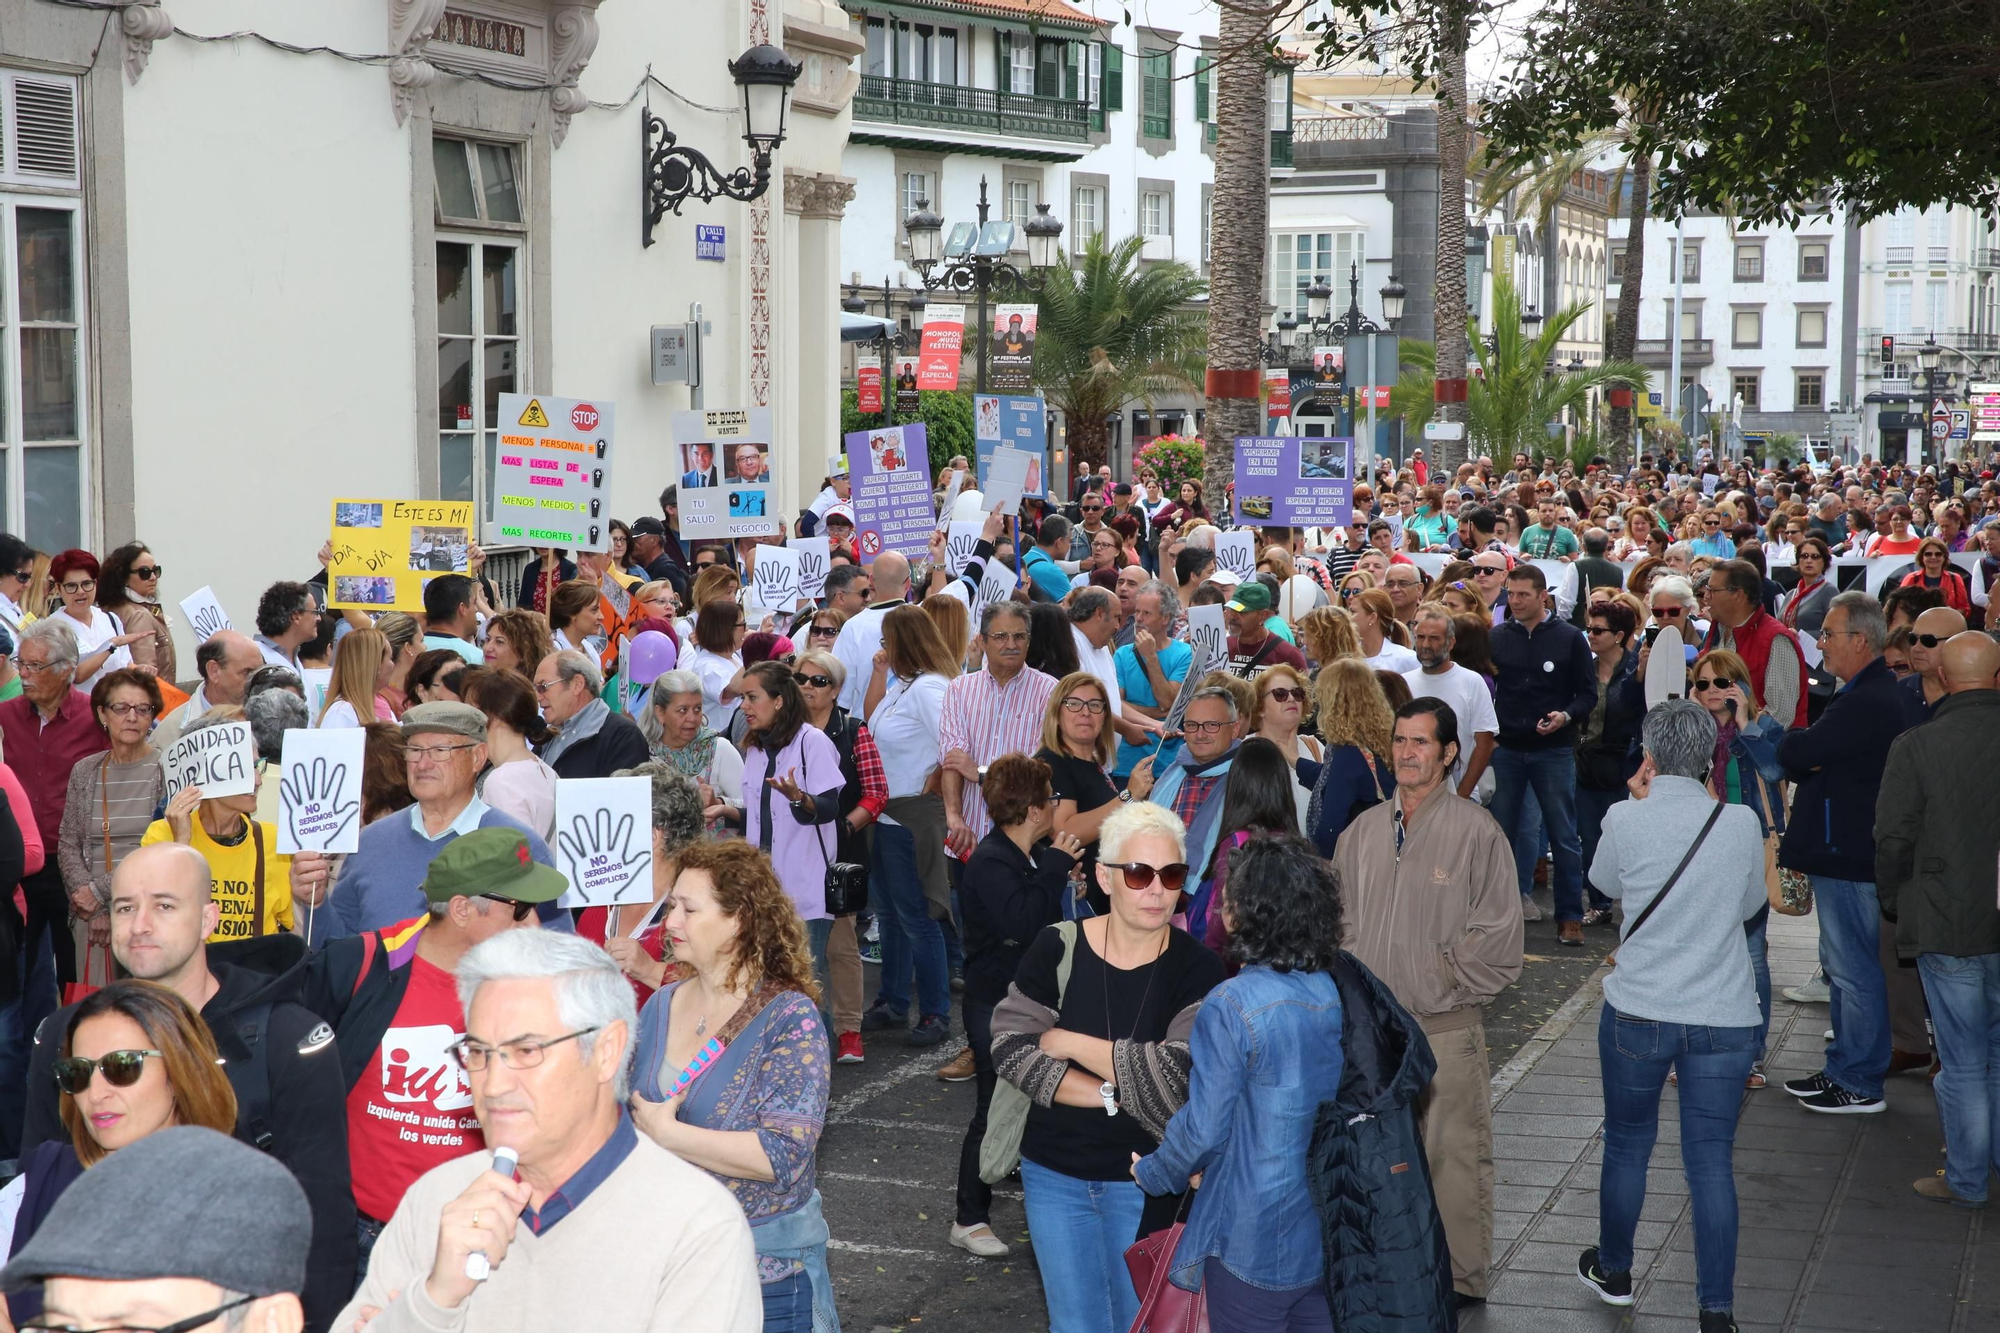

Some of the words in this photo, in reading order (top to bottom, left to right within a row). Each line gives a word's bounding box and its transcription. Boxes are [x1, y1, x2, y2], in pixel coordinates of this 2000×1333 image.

[705, 227, 724, 236] CALLE
[1501, 239, 1512, 274] Lectura
[924, 330, 961, 338] MONOPOL
[929, 342, 960, 350] FESTIVAL
[921, 370, 954, 379] ESPECIAL
[1363, 389, 1389, 398] Bter
[1650, 394, 1660, 403] 02
[1269, 403, 1290, 411] Binter
[572, 410, 598, 425] STOP
[706, 412, 717, 425] SE
[719, 410, 747, 424] BUSCA
[717, 427, 739, 435] WANTED
[1933, 425, 1947, 433] 40
[502, 436, 535, 446] MENOS
[540, 439, 585, 452] PERSONAL
[501, 456, 521, 466] MAS
[530, 458, 559, 470] LISTAS
[566, 463, 579, 473] DE
[530, 475, 564, 487] ESPERA
[863, 474, 887, 484] QUIERO
[891, 472, 921, 482] CUIDARTE
[861, 486, 885, 496] QUIERO
[888, 482, 927, 493] PROTEGERTE
[1313, 487, 1342, 495] QUIERO
[502, 496, 534, 507] MENOS
[540, 500, 575, 510] MEDIOS
[692, 500, 705, 508] TU
[856, 500, 876, 509] COMO
[878, 498, 888, 507] TU
[891, 496, 899, 505] TE
[901, 493, 928, 503] MERECES
[393, 502, 424, 520] ESTE
[428, 508, 445, 521] ES
[859, 513, 875, 522] PERO
[879, 511, 889, 520] NO
[894, 509, 904, 518] ME
[908, 507, 929, 517] DEJAN
[686, 515, 715, 525] SALUD
[882, 522, 901, 531] FALTA
[903, 518, 934, 528] PERSONAL
[502, 527, 522, 536] MAS
[529, 529, 573, 541] RECORTES
[729, 523, 771, 533] NEGOCIO
[884, 534, 903, 544] FALTA
[333, 544, 357, 566] DÍA
[909, 546, 930, 555] MEDIO
[168, 726, 246, 768] SANIDAD
[304, 802, 321, 815] NO
[298, 811, 334, 826] SEREMOS
[299, 821, 339, 835] COMPLICES
[589, 854, 609, 868] NO
[583, 862, 623, 879] SEREMOS
[584, 872, 629, 889] COMPLICES
[222, 880, 249, 896] NO
[366, 1101, 421, 1126] izquierda
[423, 1115, 456, 1130] unida
[458, 1116, 482, 1130] Cana
[399, 1126, 420, 1143] los
[422, 1133, 463, 1146] verdes
